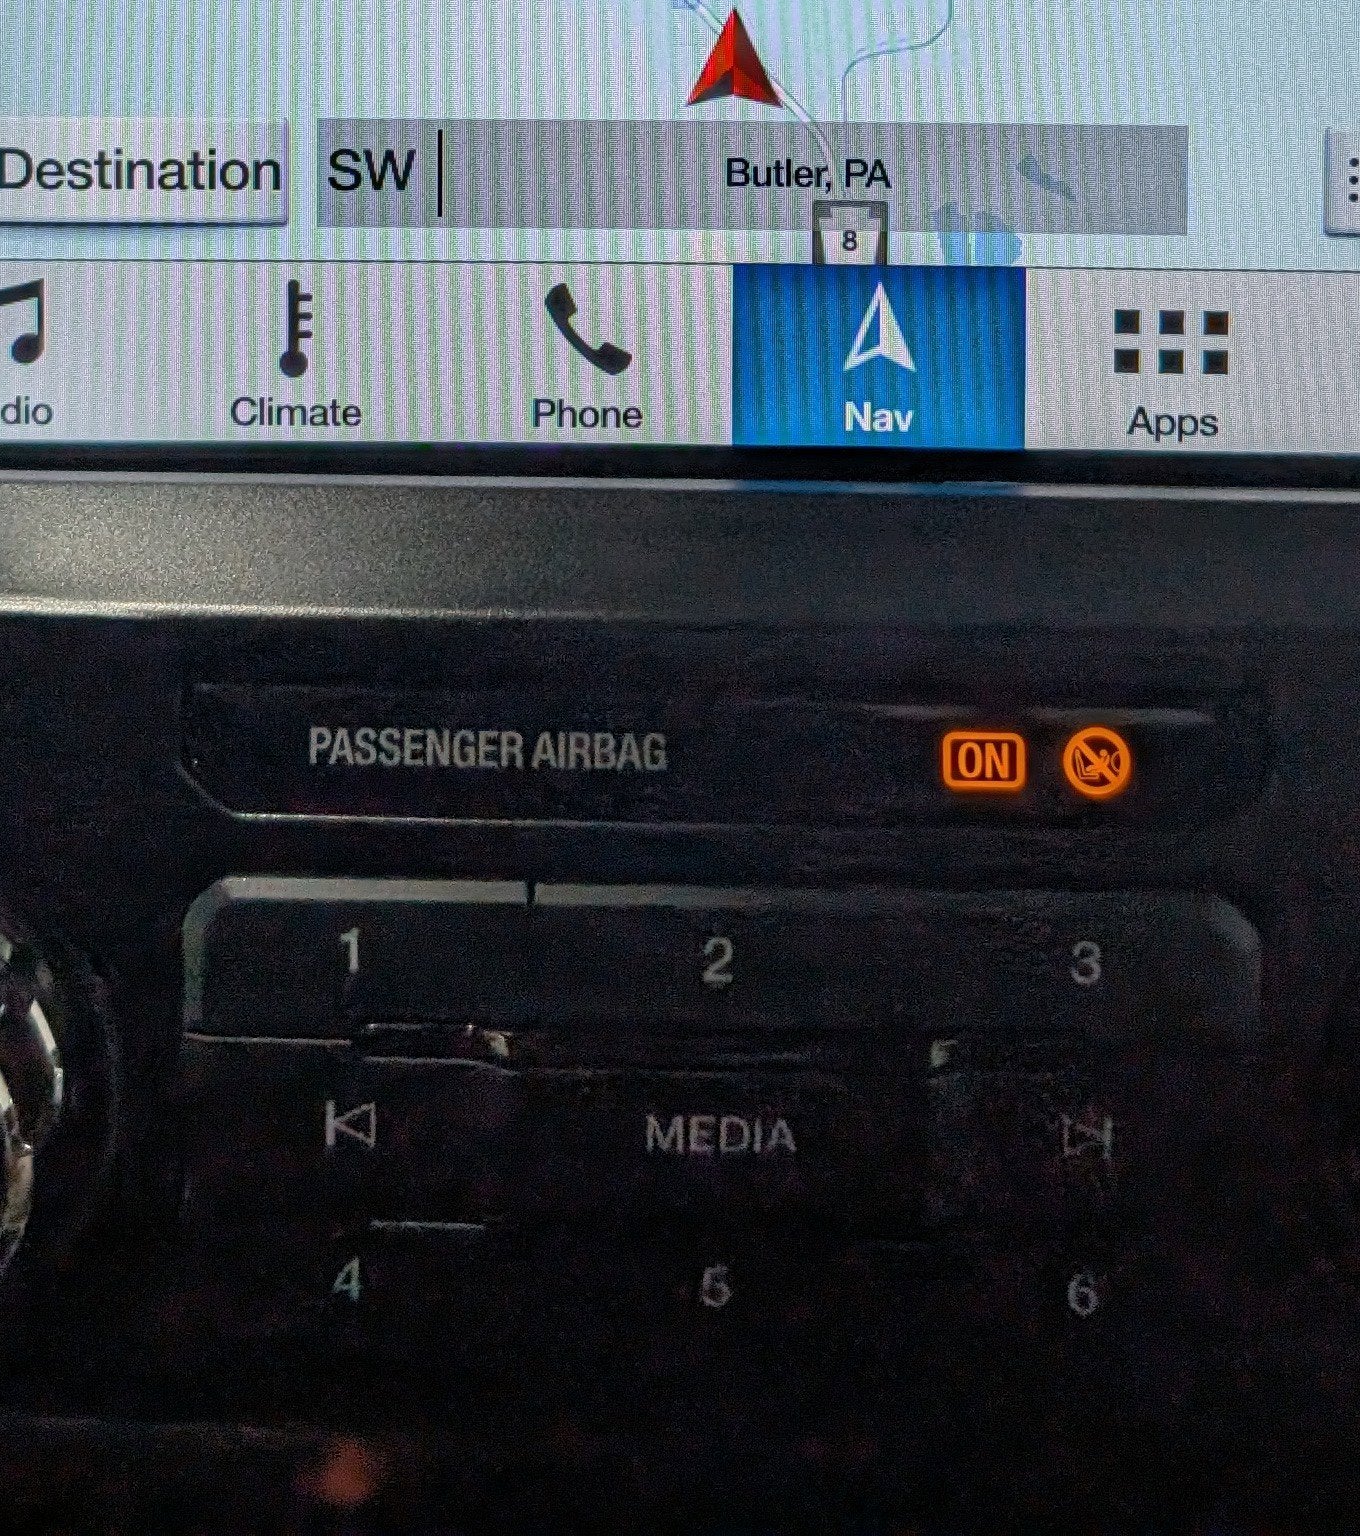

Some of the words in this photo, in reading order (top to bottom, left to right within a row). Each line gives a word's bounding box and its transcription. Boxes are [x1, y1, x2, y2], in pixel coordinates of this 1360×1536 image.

[327, 148, 416, 192] SW
[725, 157, 832, 195] Butler,
[843, 158, 891, 190] PA
[842, 230, 858, 252] 8
[230, 396, 362, 428] Climate
[532, 398, 643, 429] Phone
[844, 402, 914, 434] Nav
[1127, 406, 1219, 442] Apps
[308, 726, 524, 769] PASSENGER
[531, 730, 667, 772] AIRBAG
[957, 740, 1012, 781] ON
[338, 927, 363, 974] 1
[702, 938, 733, 985] 2
[1069, 941, 1103, 987] 3
[646, 1115, 797, 1156] MEDIA
[331, 1258, 362, 1302] 4
[699, 1266, 732, 1308] 5
[1067, 1272, 1100, 1316] 6
